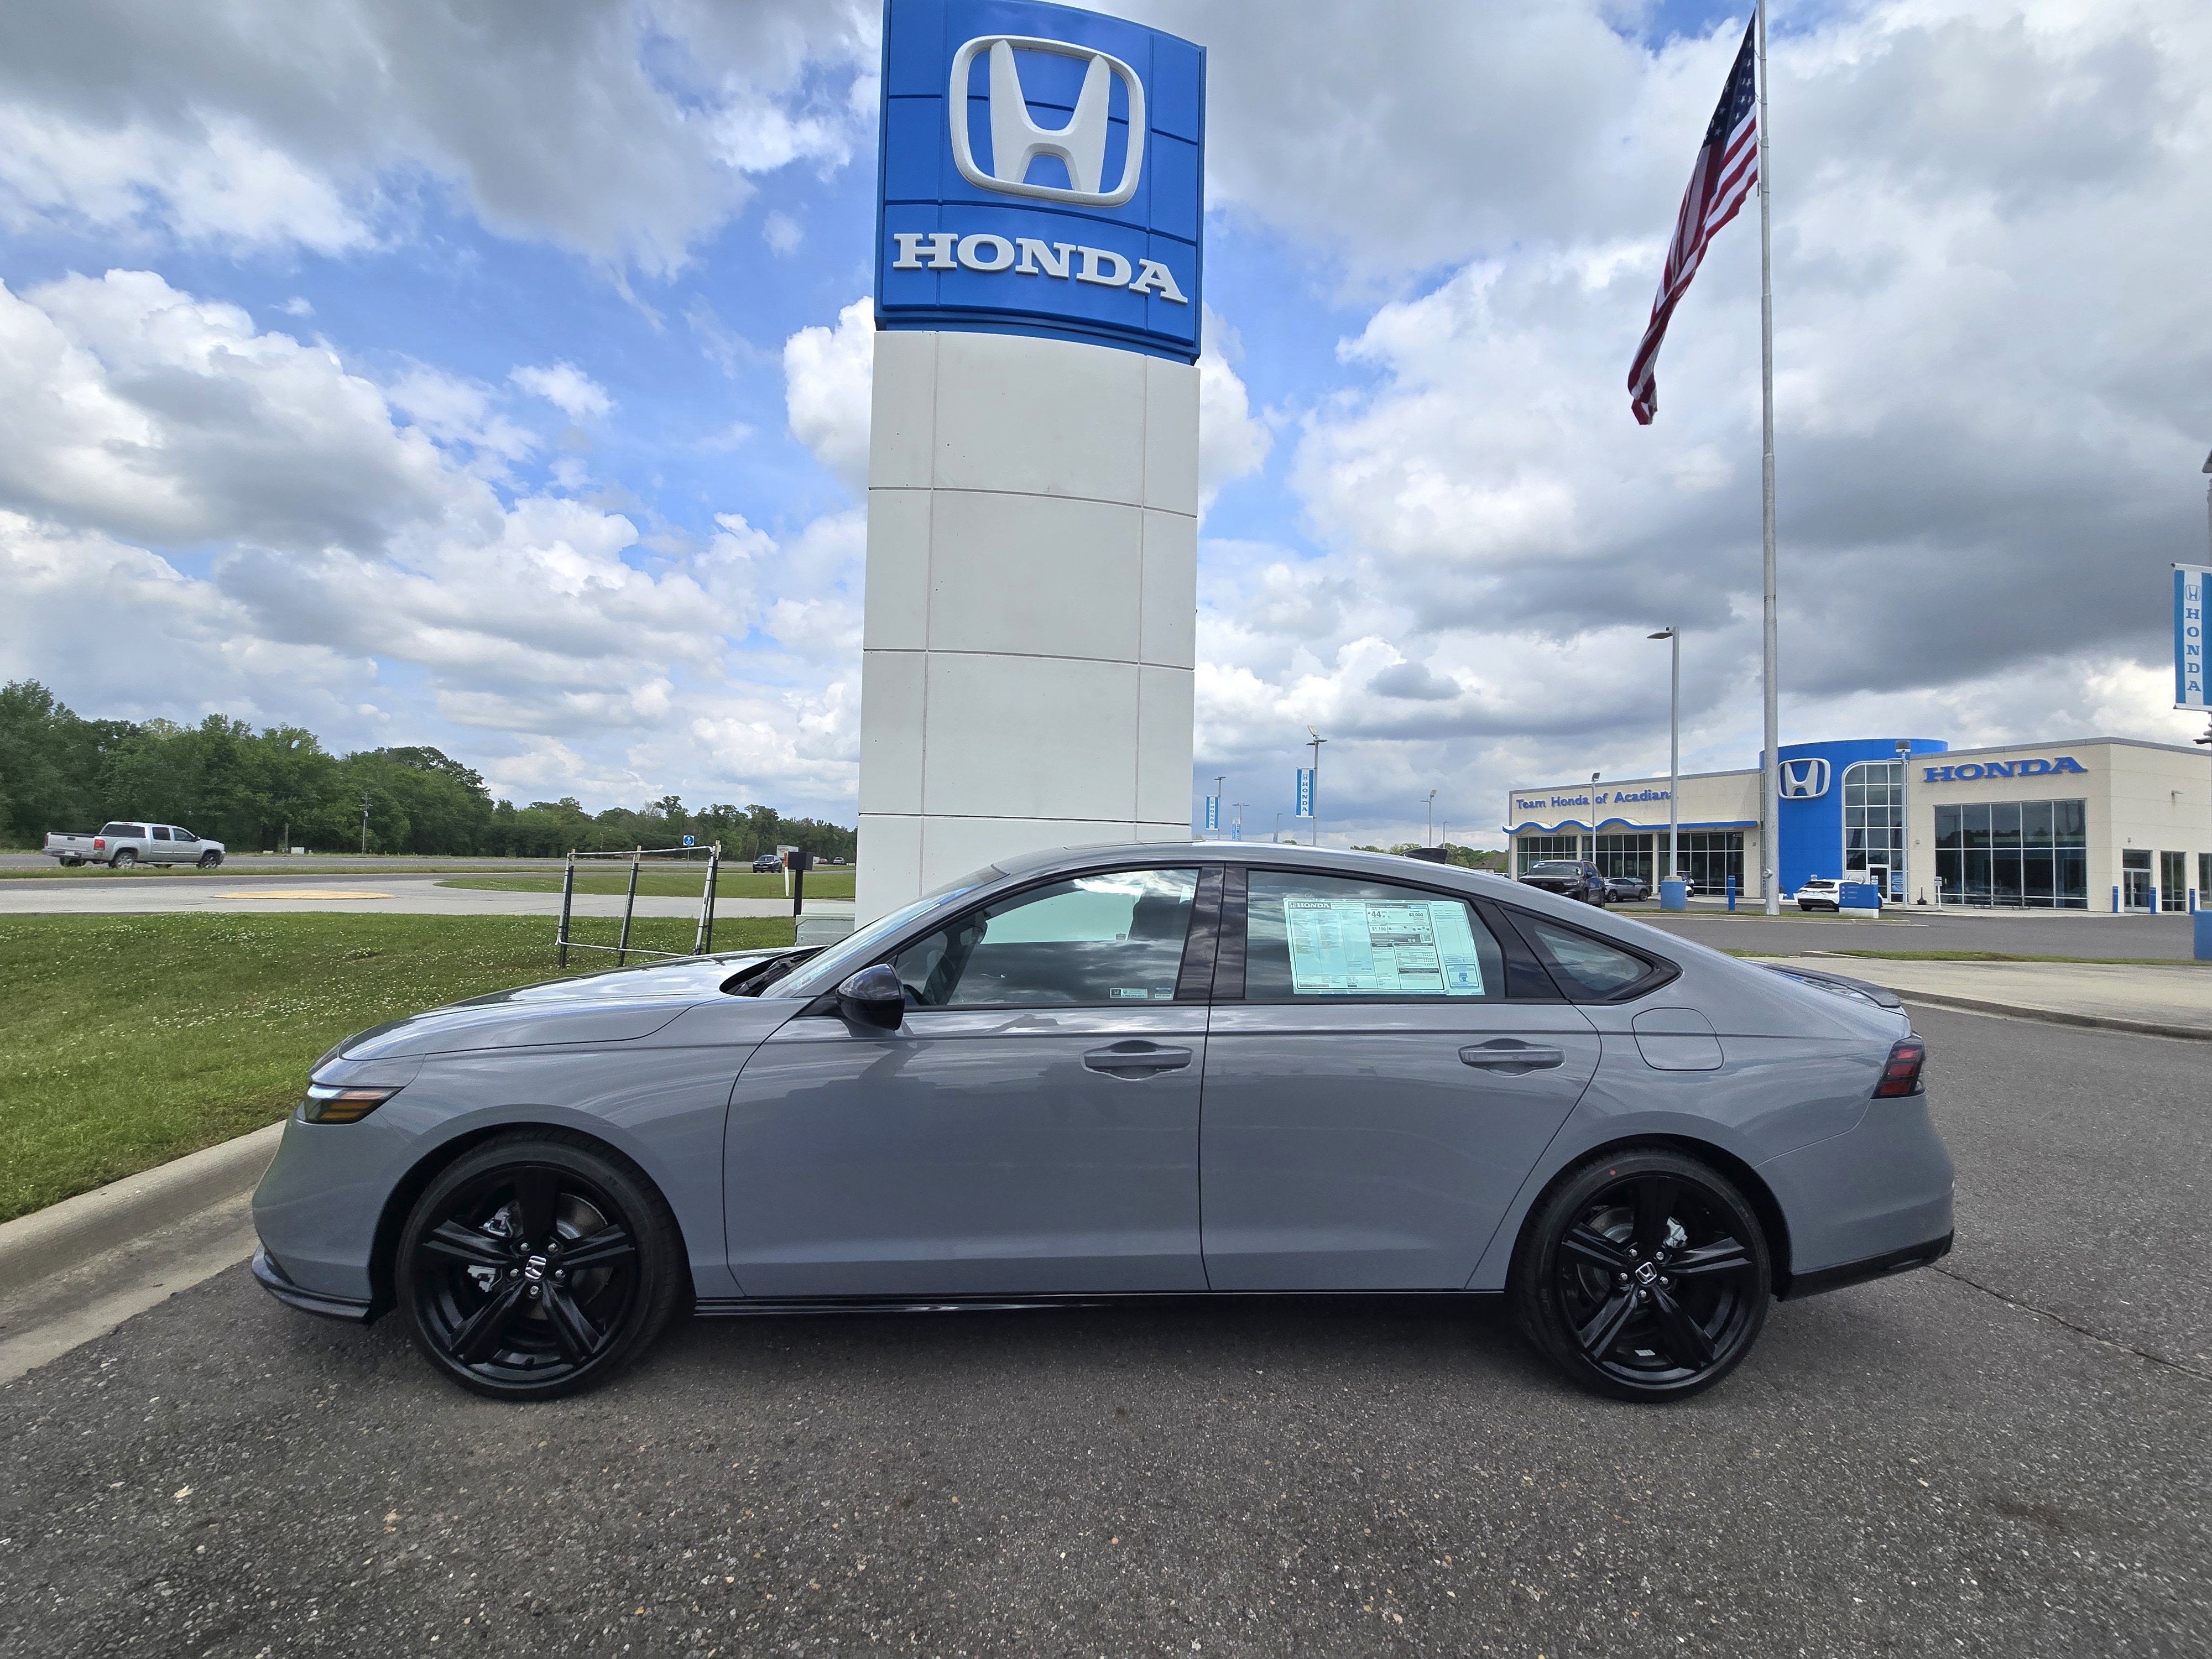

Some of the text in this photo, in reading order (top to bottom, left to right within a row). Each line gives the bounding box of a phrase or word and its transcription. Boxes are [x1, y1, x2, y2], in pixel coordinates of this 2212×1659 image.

[893, 232, 1188, 305] HONDA
[2185, 607, 2201, 692] HONDA
[1923, 756, 2088, 782] HONDA
[1516, 789, 1679, 810] Team Honda of Acadian
